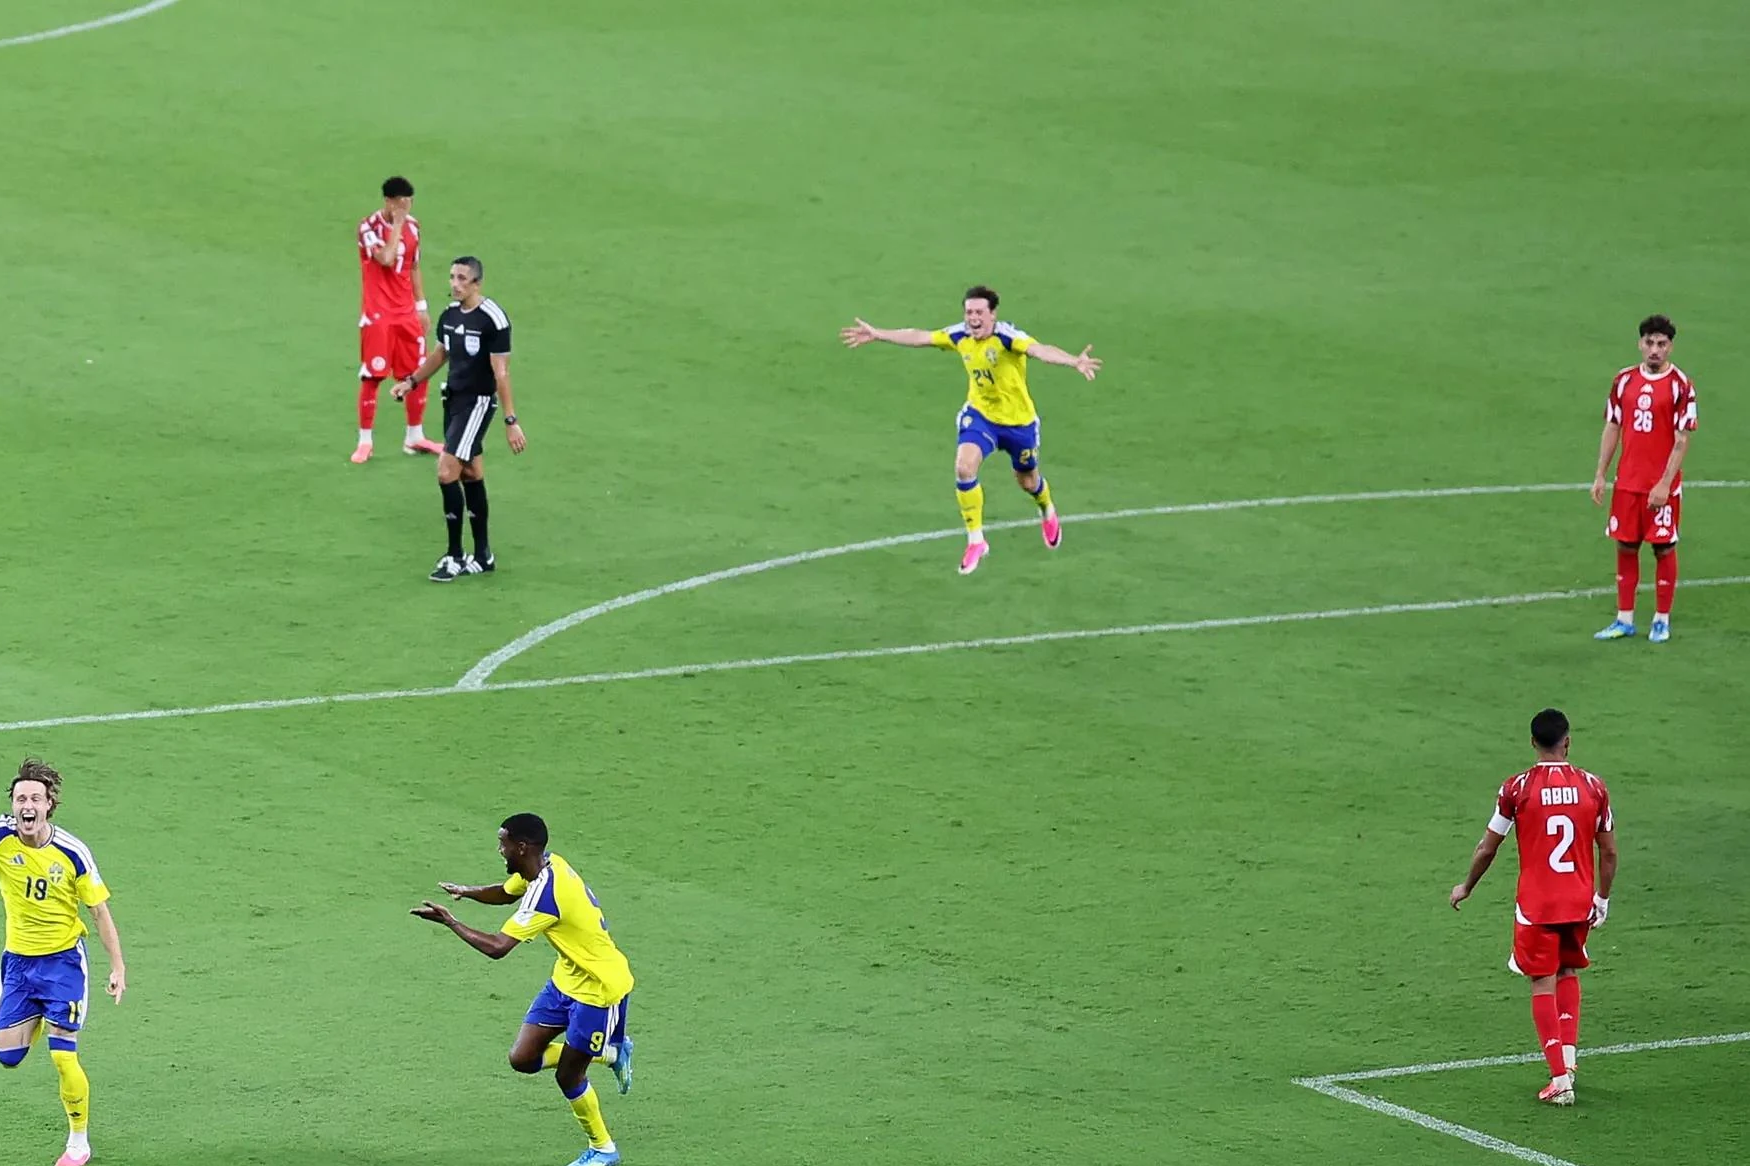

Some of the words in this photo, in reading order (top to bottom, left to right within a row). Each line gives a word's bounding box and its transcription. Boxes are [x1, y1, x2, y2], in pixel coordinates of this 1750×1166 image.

[972, 369, 995, 387] 24
[1633, 408, 1654, 433] 26
[1654, 504, 1672, 527] 26
[1540, 786, 1579, 806] ABDI
[1546, 814, 1576, 874] 2
[25, 875, 48, 901] 19
[589, 1031, 605, 1052] 9
